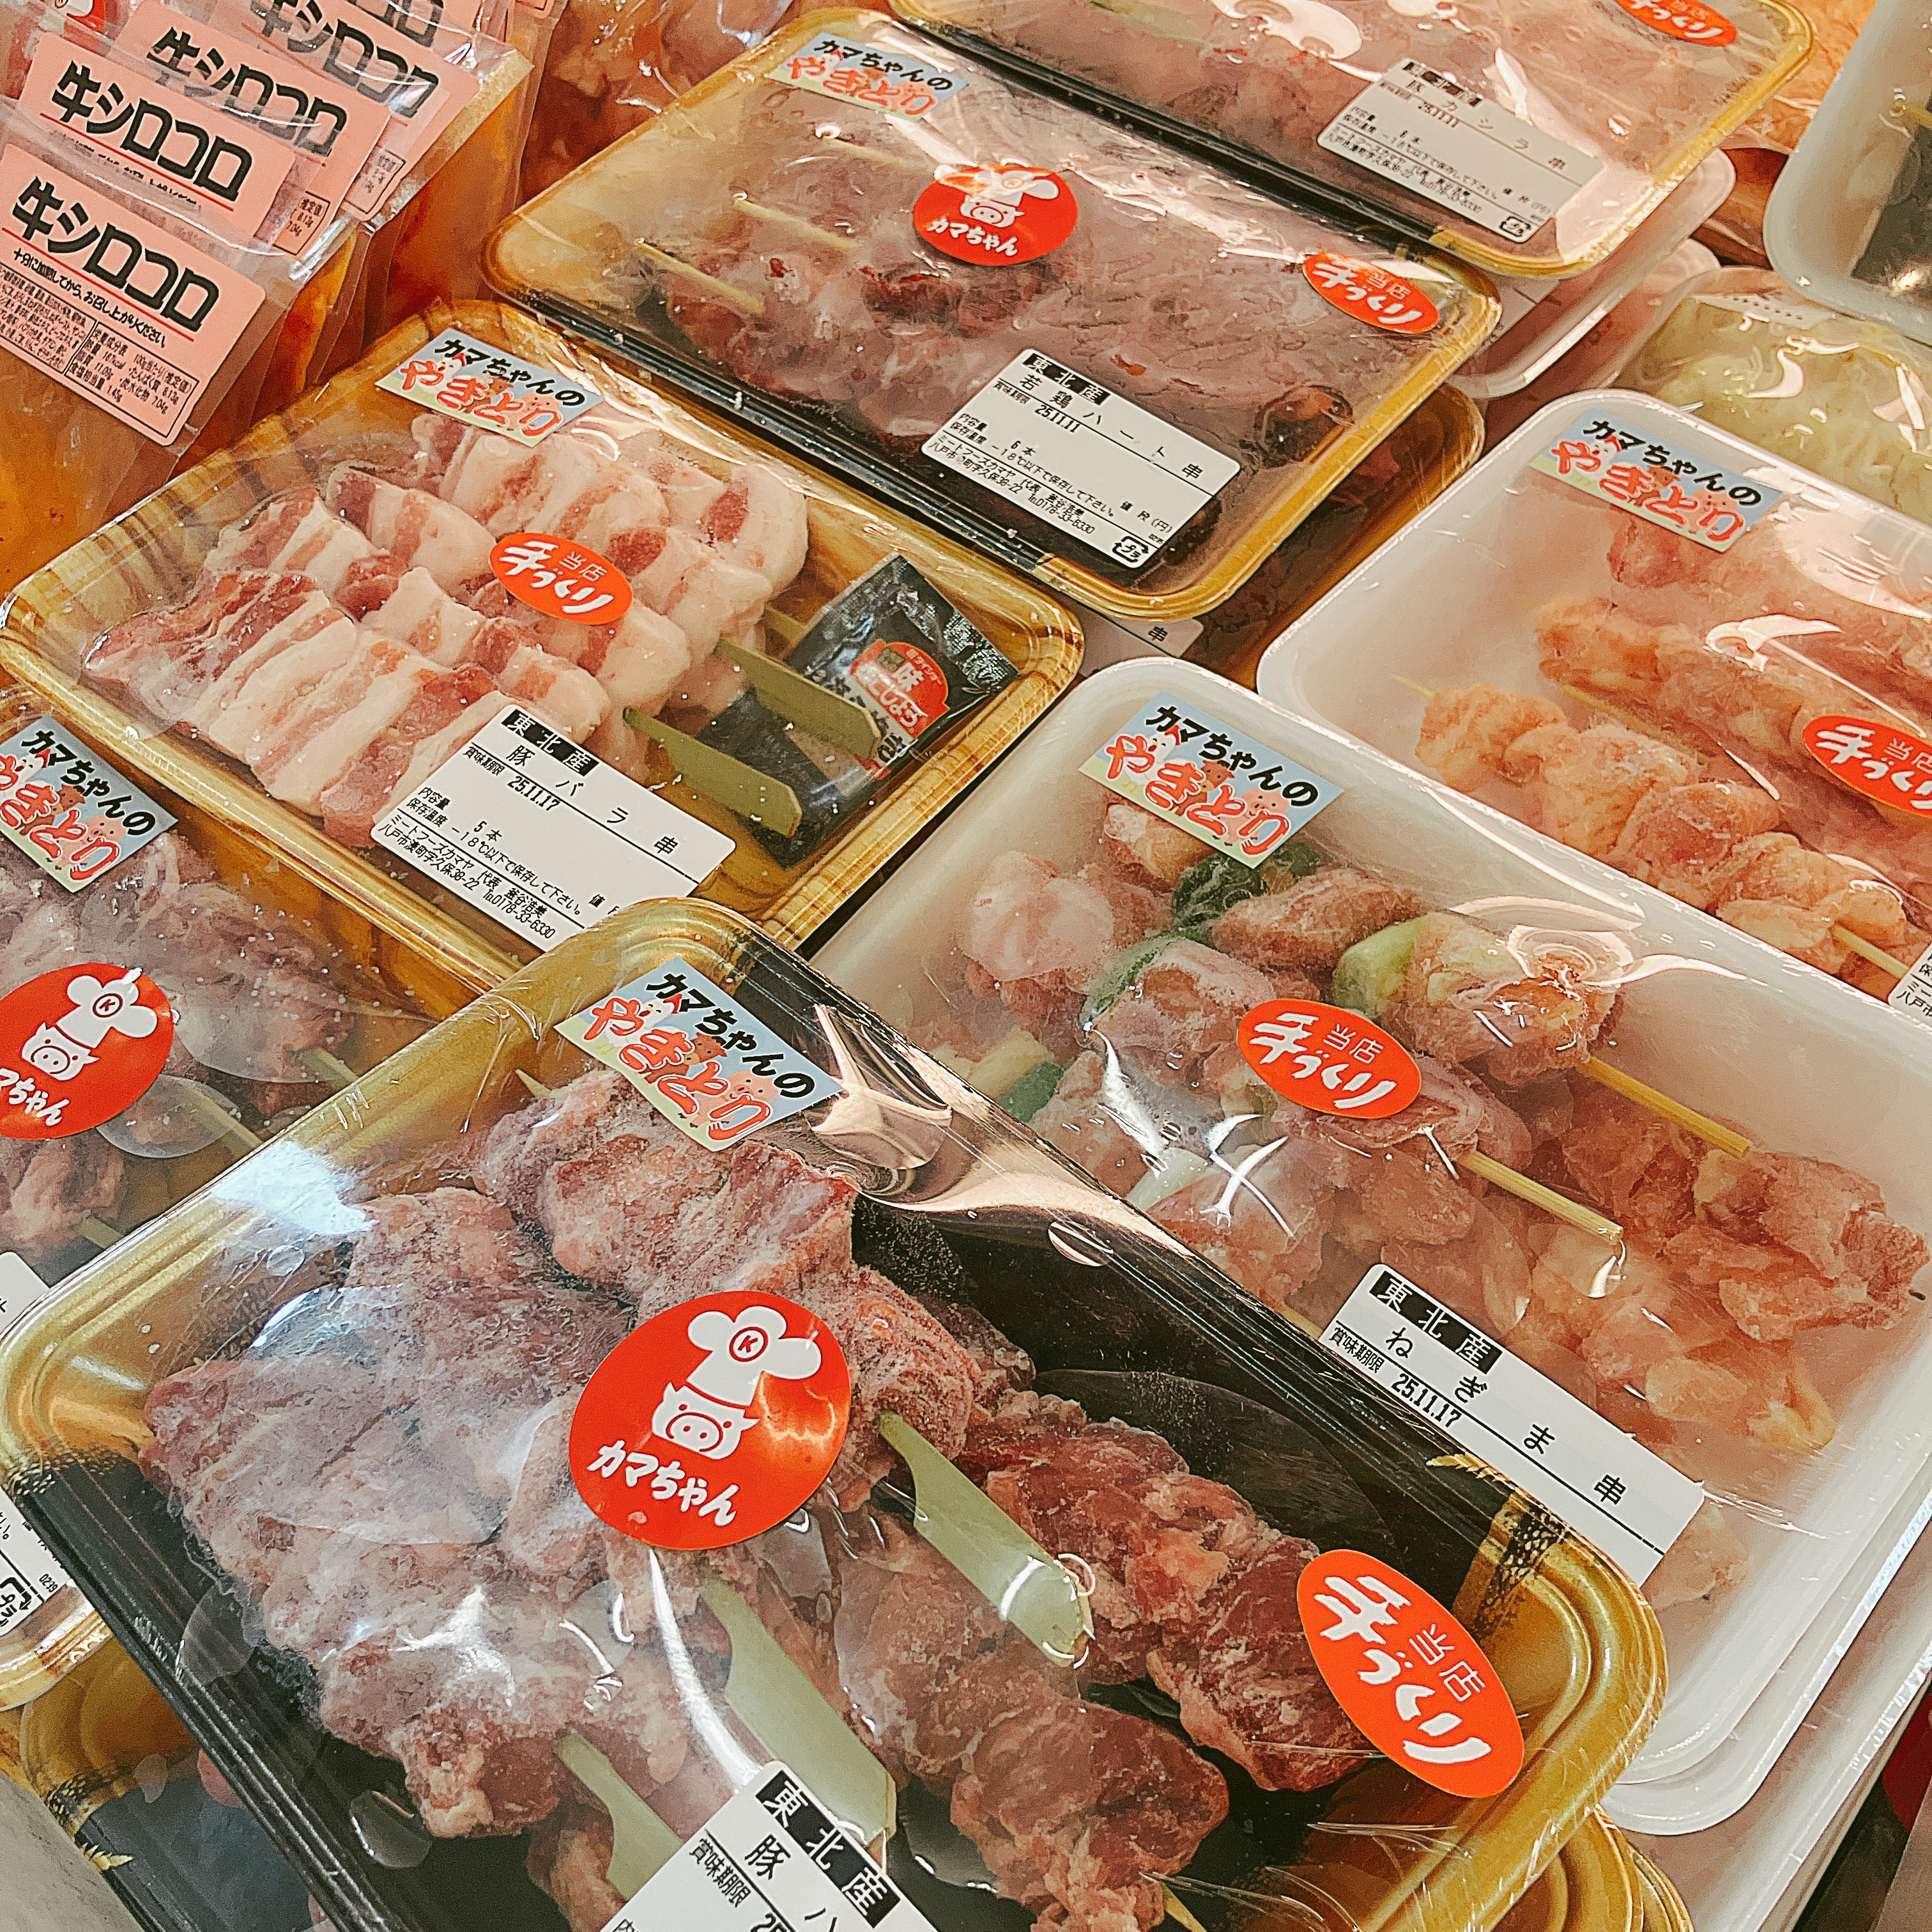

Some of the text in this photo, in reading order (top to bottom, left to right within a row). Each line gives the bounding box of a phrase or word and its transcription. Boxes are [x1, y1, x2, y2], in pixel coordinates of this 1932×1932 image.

[146, 27, 348, 157] 牛シロコロ
[786, 56, 937, 116] やきとり
[813, 39, 953, 90] カマちゃんの
[52, 61, 253, 202] 牛シロコロ
[12, 176, 221, 333] 牛シロコロ
[926, 218, 1018, 257] カマちゃん
[1312, 262, 1423, 325] 手づくり
[400, 359, 564, 437] やきとり
[434, 338, 585, 406] カマちゃんの
[1027, 356, 1105, 404] 東北産
[1019, 374, 1203, 482] 若鶏ハート串
[1583, 419, 1762, 507] カマちゃんの
[1551, 441, 1745, 543] やきとり
[500, 540, 615, 614] 手づくり
[559, 551, 608, 581] 当店
[21, 730, 156, 836] カマちゃんの
[463, 746, 562, 813] 賞味期限 25.11.17
[507, 712, 592, 774] 東北産
[1145, 706, 1319, 806] カマちゃんの
[406, 797, 448, 829] 保存温度
[417, 786, 451, 810] 内容量
[506, 745, 679, 855] 豚バラ串
[1105, 734, 1291, 856] やきとり
[390, 813, 475, 871] ミートフーズカマヤ
[480, 869, 500, 891] 代表
[582, 996, 772, 1142] やきとり
[645, 972, 815, 1099] カマちゃんの
[1249, 1012, 1397, 1109] 手づくり
[1322, 1023, 1384, 1064] 当店
[1376, 1276, 1492, 1368] 東北産
[1333, 1327, 1463, 1429] 賞味期限 25.11.17
[1385, 1327, 1627, 1506] ねぎま串
[586, 1439, 740, 1527] カマちゃん
[1314, 1575, 1492, 1765] 手づくり
[1409, 1623, 1487, 1703] 当店
[689, 1837, 751, 1908] 賞味期限
[763, 1779, 890, 1917] 東北産
